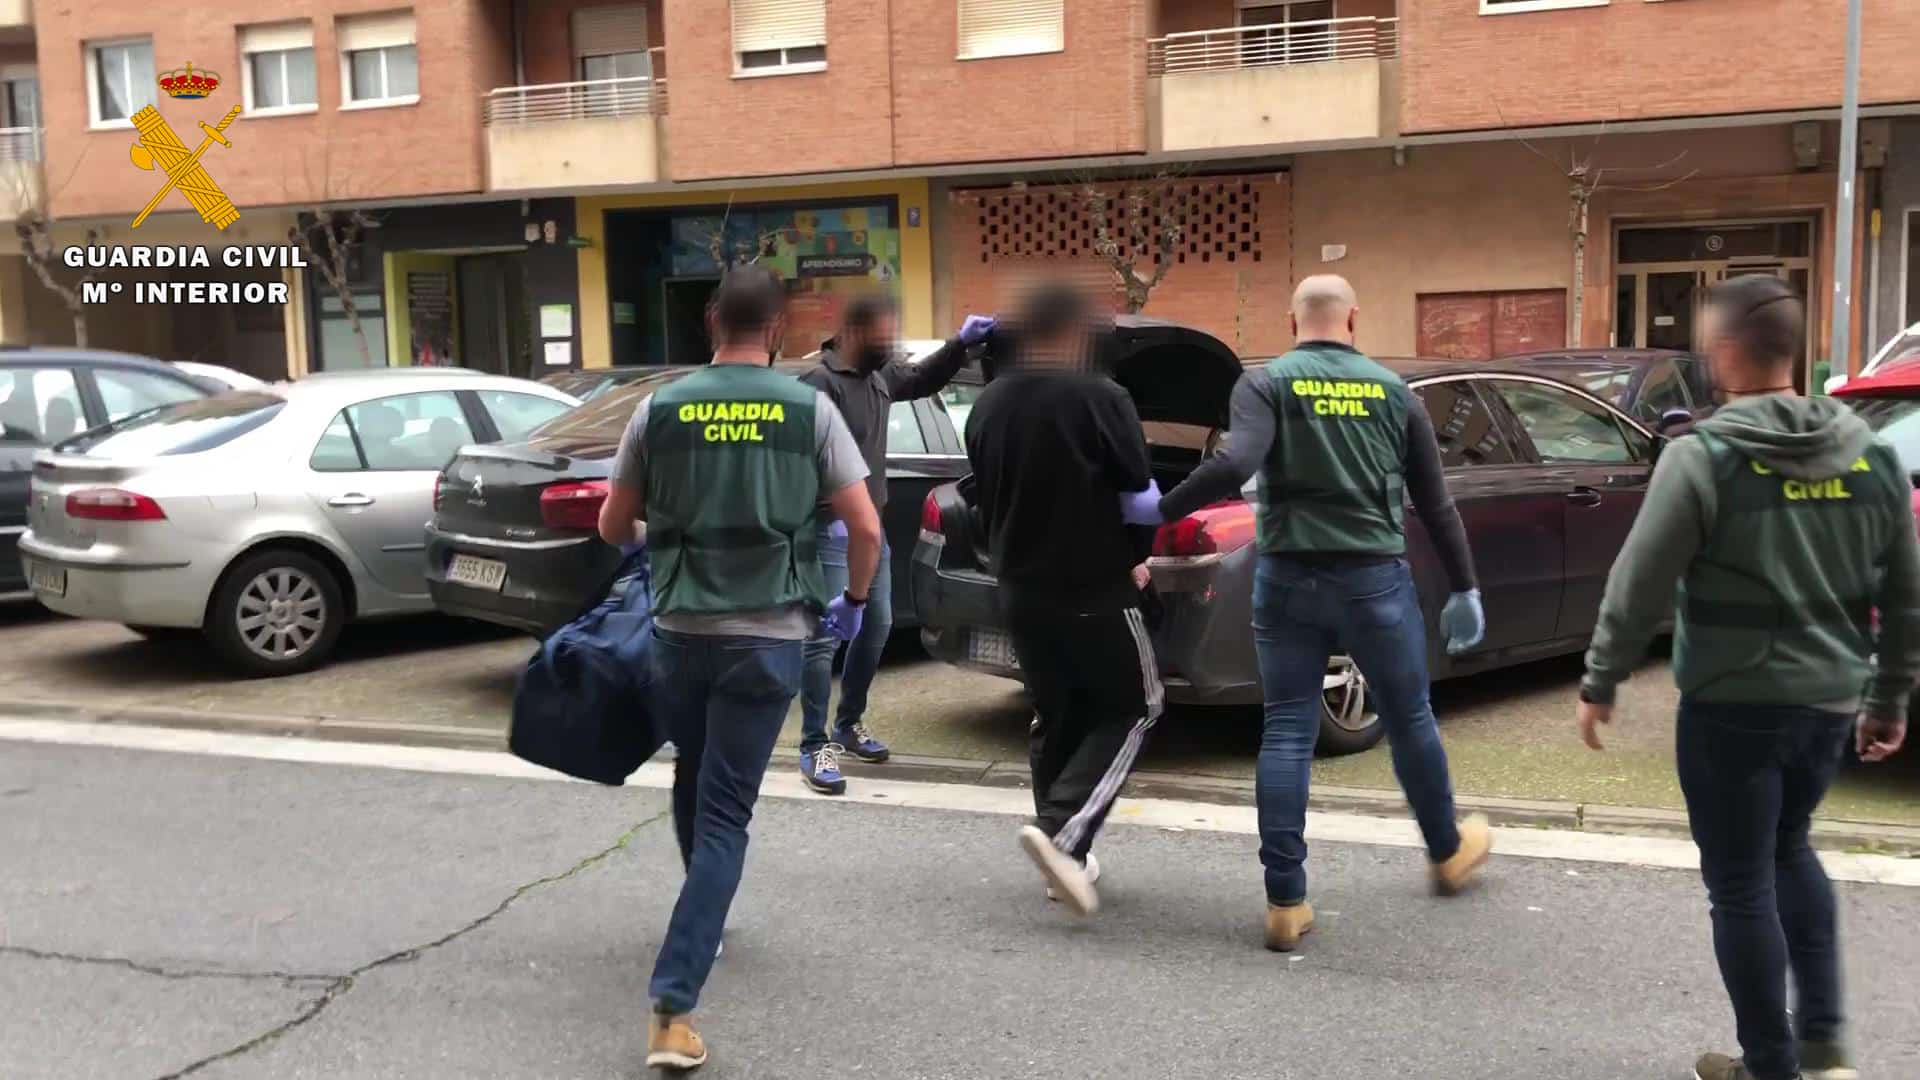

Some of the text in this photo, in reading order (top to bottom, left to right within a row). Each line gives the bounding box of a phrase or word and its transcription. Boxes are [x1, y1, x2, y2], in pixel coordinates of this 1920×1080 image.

[1292, 380, 1386, 400] GUARDIA
[679, 403, 785, 423] GUARDIA
[1313, 399, 1370, 417] CIVIL
[703, 423, 764, 442] CIVIL
[1783, 479, 1853, 500] CIVIL
